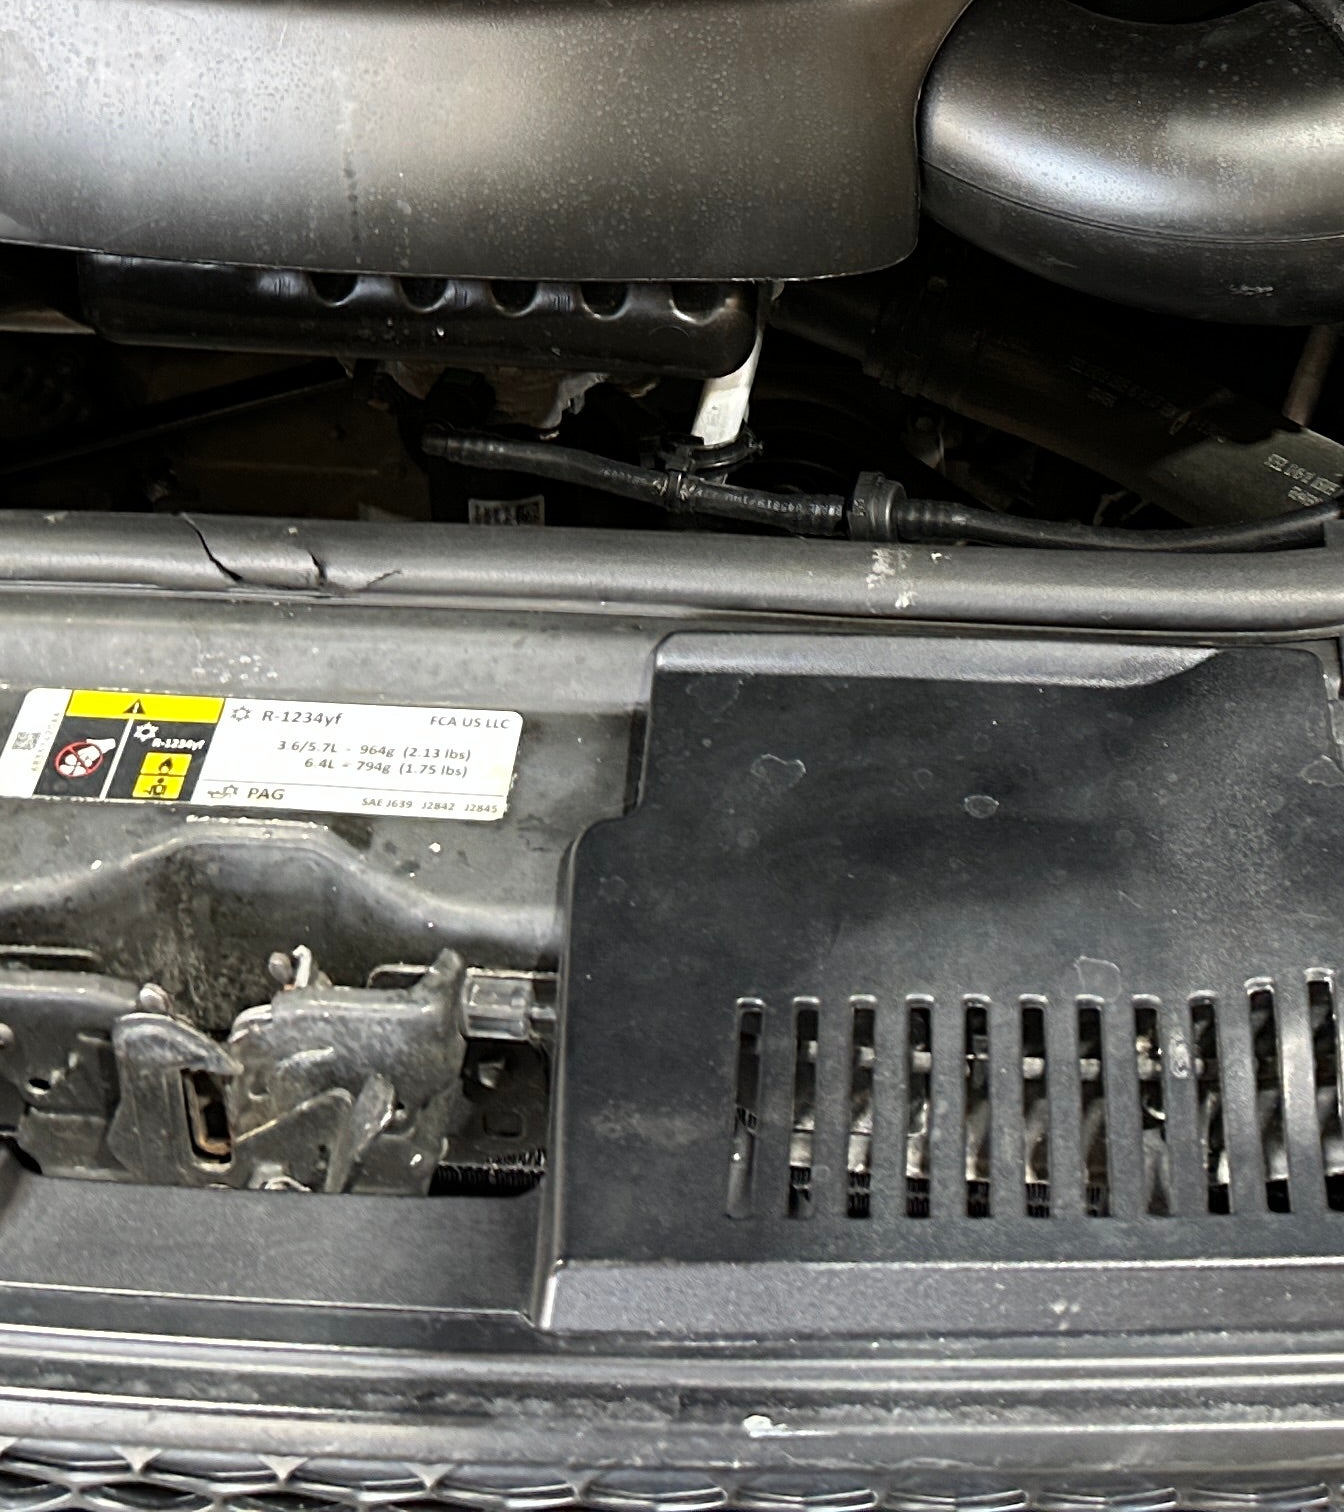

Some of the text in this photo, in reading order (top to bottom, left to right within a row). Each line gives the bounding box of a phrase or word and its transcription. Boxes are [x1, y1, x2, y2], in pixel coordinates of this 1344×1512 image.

[261, 710, 343, 727] R-1234yf
[430, 715, 510, 729] FCA US LLC
[277, 740, 337, 753] 3.6/5.7L
[359, 744, 396, 758] 964g
[444, 748, 471, 762] lbs)
[304, 757, 335, 769] 6.4L
[356, 760, 392, 775] 794g
[441, 764, 468, 778] lbs)
[247, 787, 285, 800] PAG
[361, 797, 384, 807] SAE
[386, 799, 413, 809] J639
